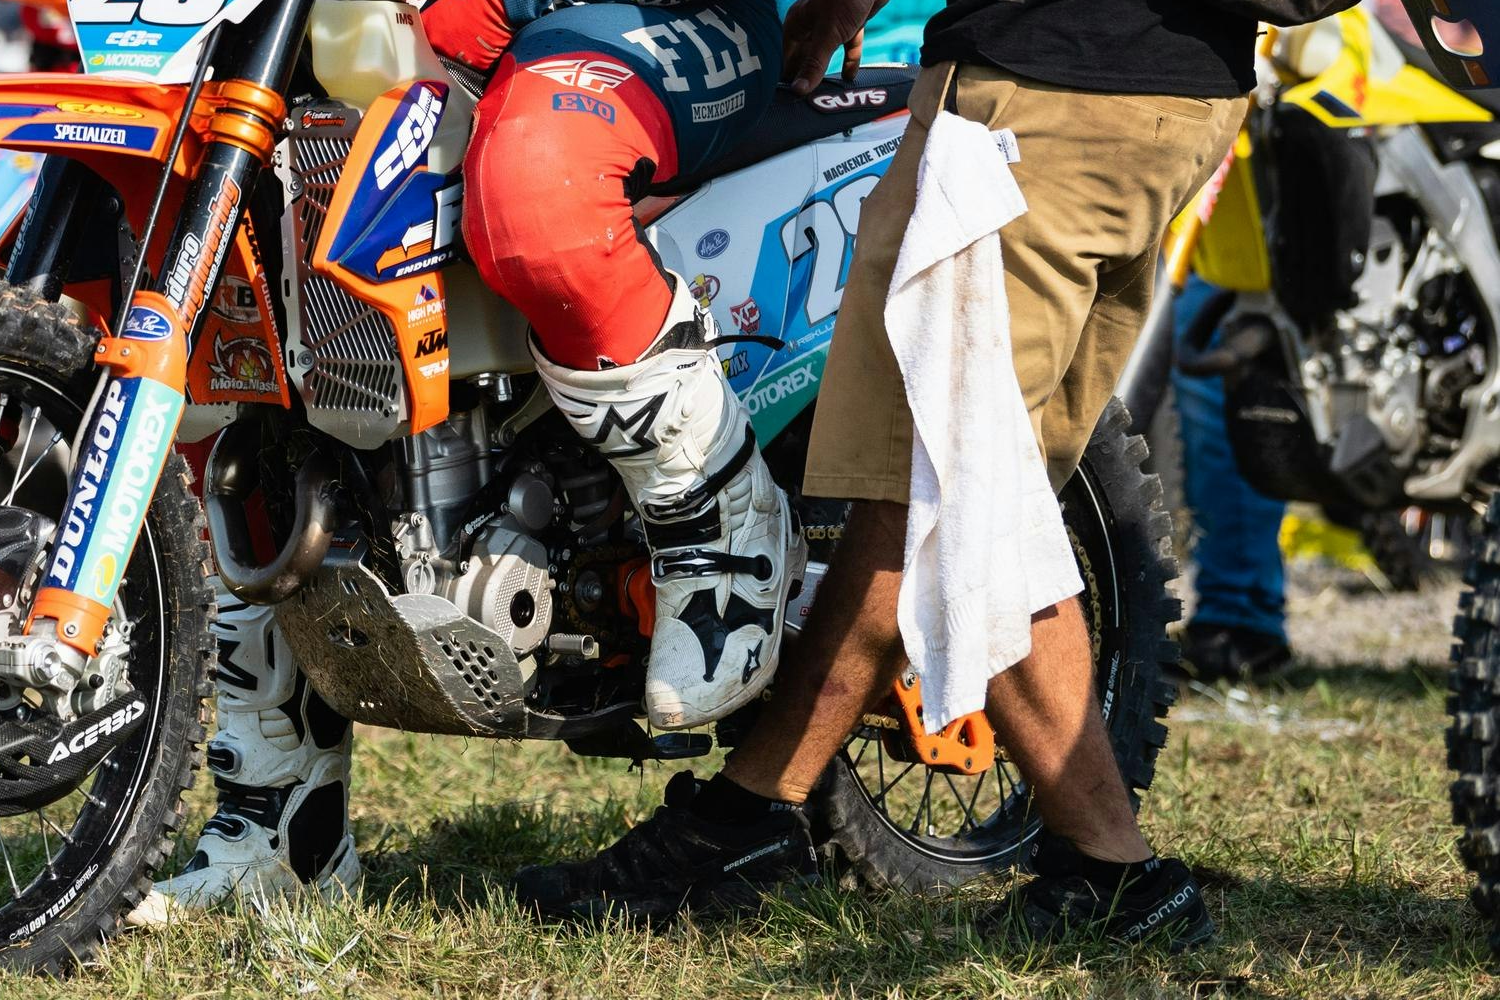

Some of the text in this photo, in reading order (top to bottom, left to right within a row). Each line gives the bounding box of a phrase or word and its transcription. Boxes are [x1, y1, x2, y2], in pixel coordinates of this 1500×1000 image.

[395, 12, 414, 26] IMS
[104, 53, 164, 68] MOTOREX
[621, 4, 762, 92] FLY
[556, 93, 612, 120] EVO
[693, 90, 745, 122] MCMXCVIII
[812, 88, 888, 110] GUTS
[53, 123, 126, 145] SPECIALIZED
[822, 135, 903, 184] MACKENZIE TRICKE
[179, 178, 241, 334] Engineering
[202, 207, 238, 301] TUNED SUSPENSION
[394, 252, 447, 278] ENDURO
[407, 298, 446, 325] HIGH POINT
[414, 327, 449, 360] KTM
[721, 350, 750, 379] PMX
[747, 361, 819, 416] OTOREX
[49, 379, 127, 589] DUNLOP
[102, 395, 173, 556] MOTOREX
[1101, 689, 1115, 722] EXC
[45, 885, 78, 919] EXCEL
[28, 912, 47, 932] A60
